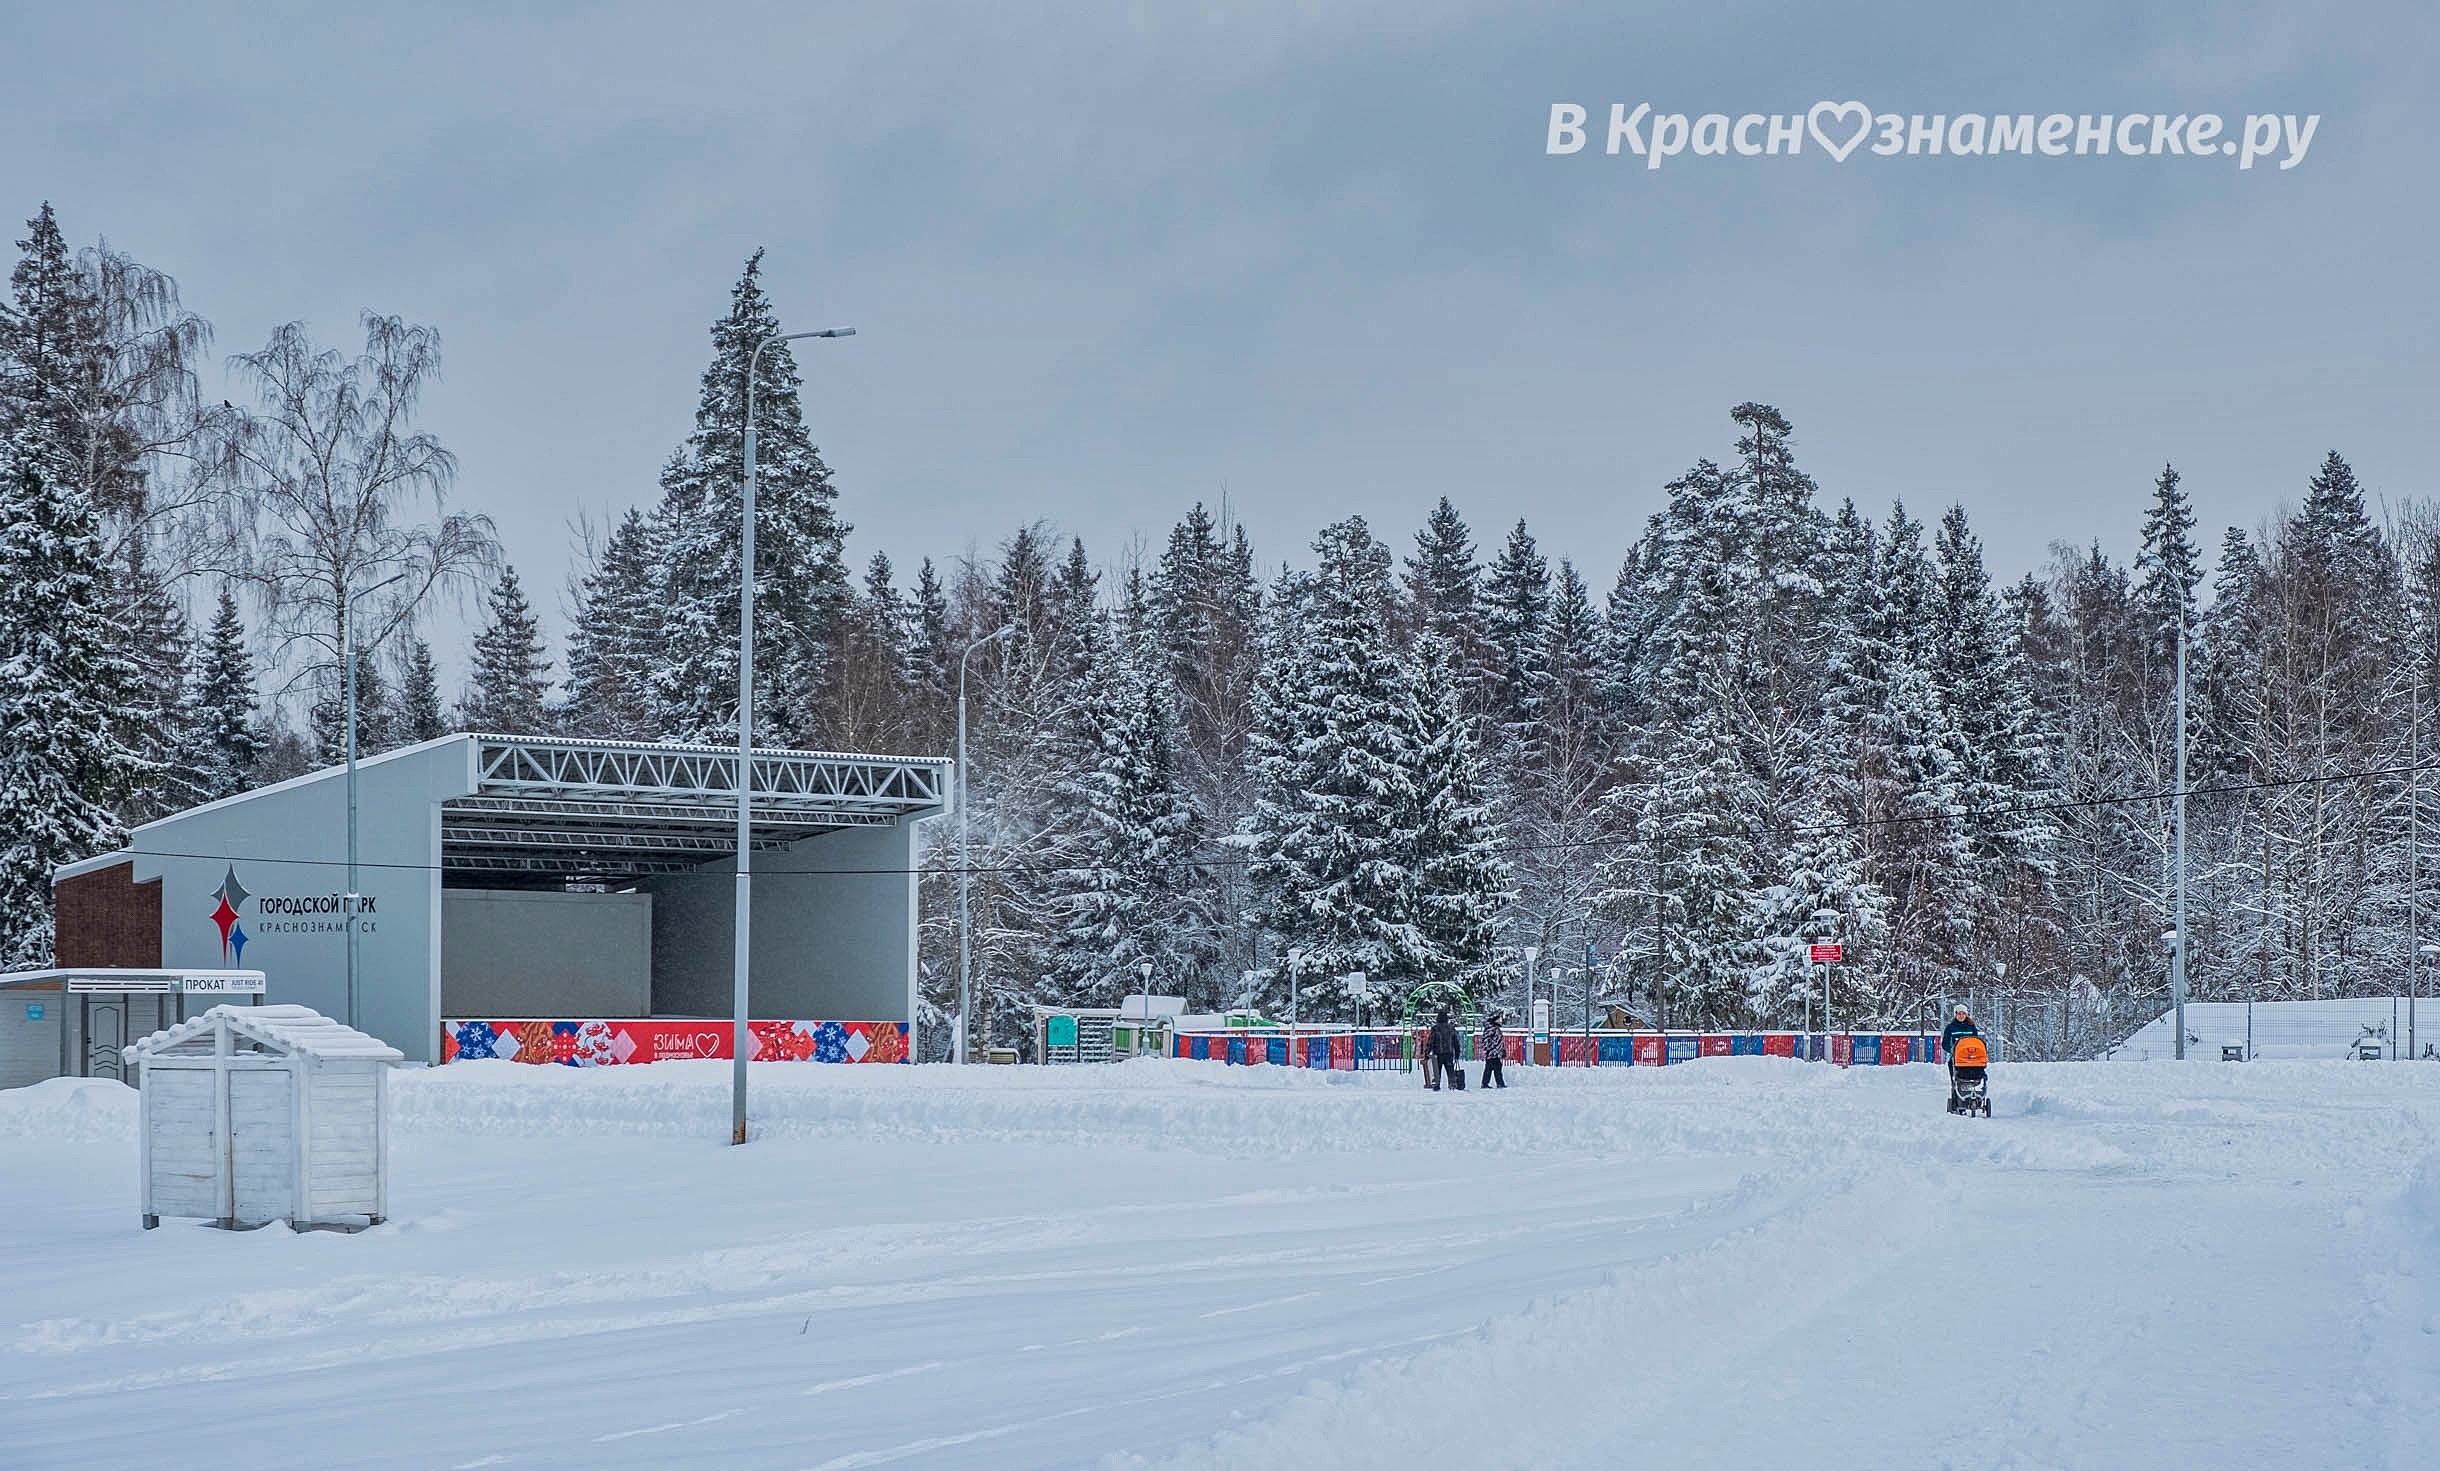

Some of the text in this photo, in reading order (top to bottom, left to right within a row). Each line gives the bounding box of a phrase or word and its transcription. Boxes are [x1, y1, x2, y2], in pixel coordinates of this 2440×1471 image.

[260, 893, 377, 915] ГОРОДСКОЙ ПРК
[259, 921, 377, 933] КРАСНОЗНАМЕСК
[185, 979, 225, 990] ПРОКАТ
[654, 1033, 695, 1050] ЗИМА
